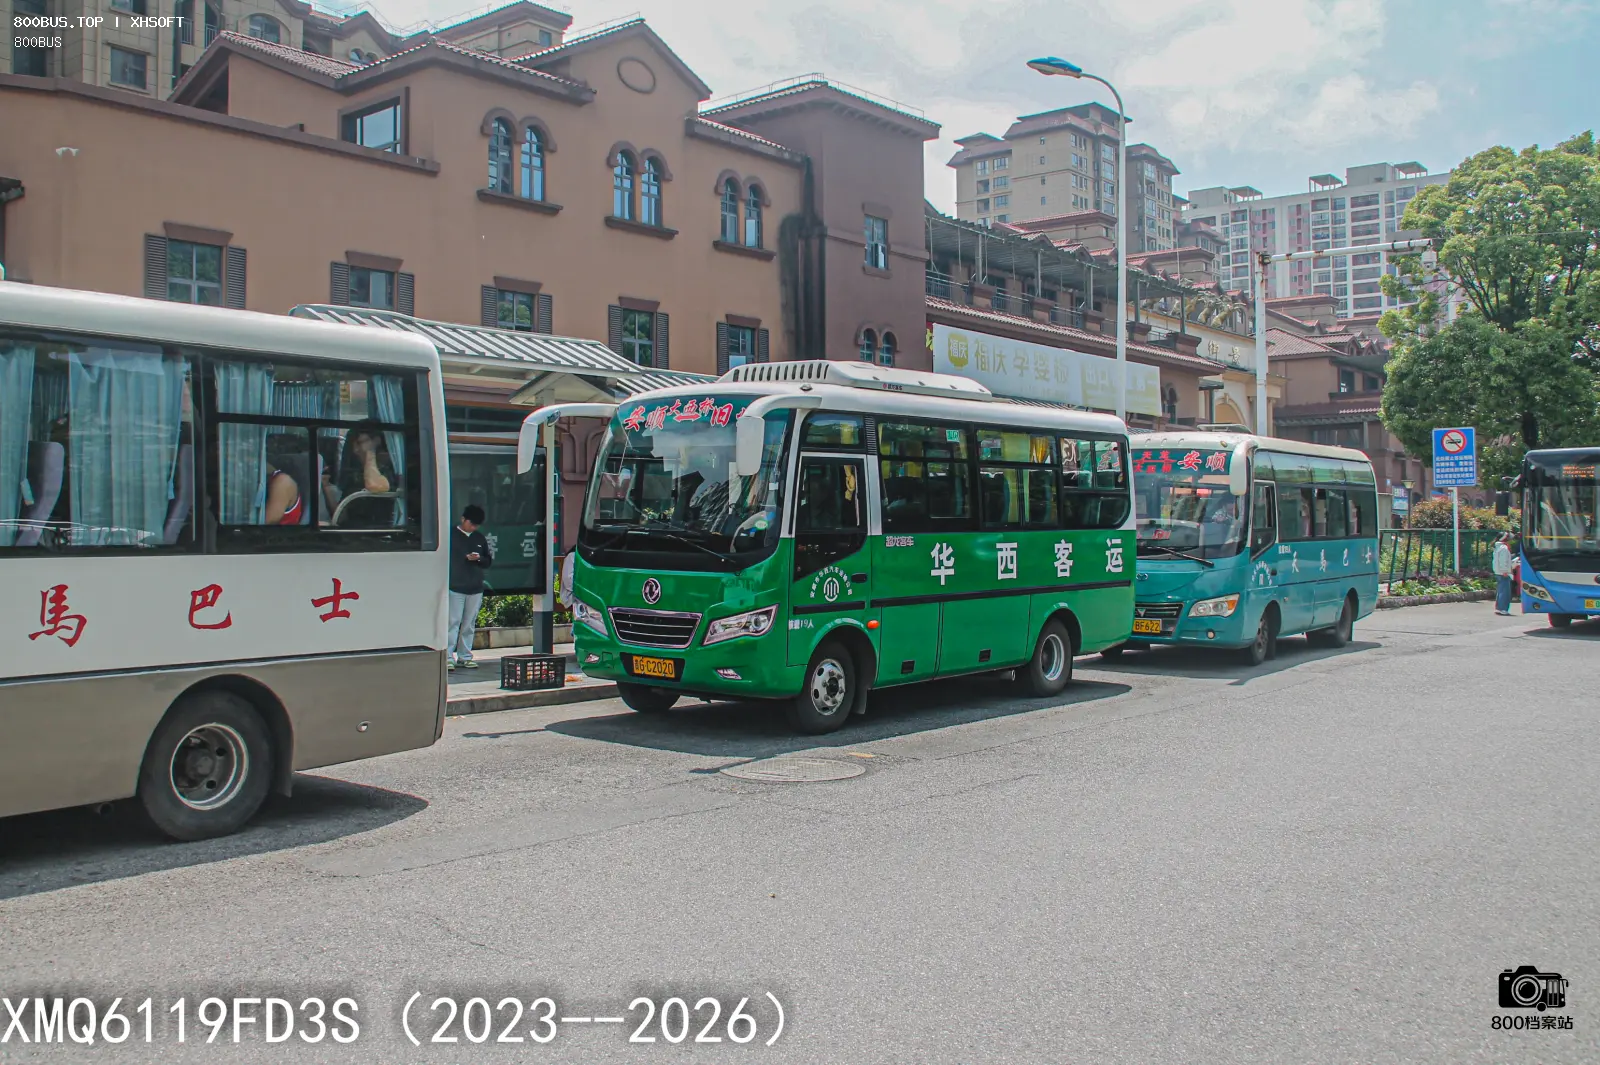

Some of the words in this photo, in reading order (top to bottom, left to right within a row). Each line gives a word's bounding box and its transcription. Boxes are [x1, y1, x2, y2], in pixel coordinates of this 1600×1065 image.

[624, 405, 669, 431] 安顺
[1177, 450, 1227, 471] 安顺
[930, 538, 1123, 586] 华西客运
